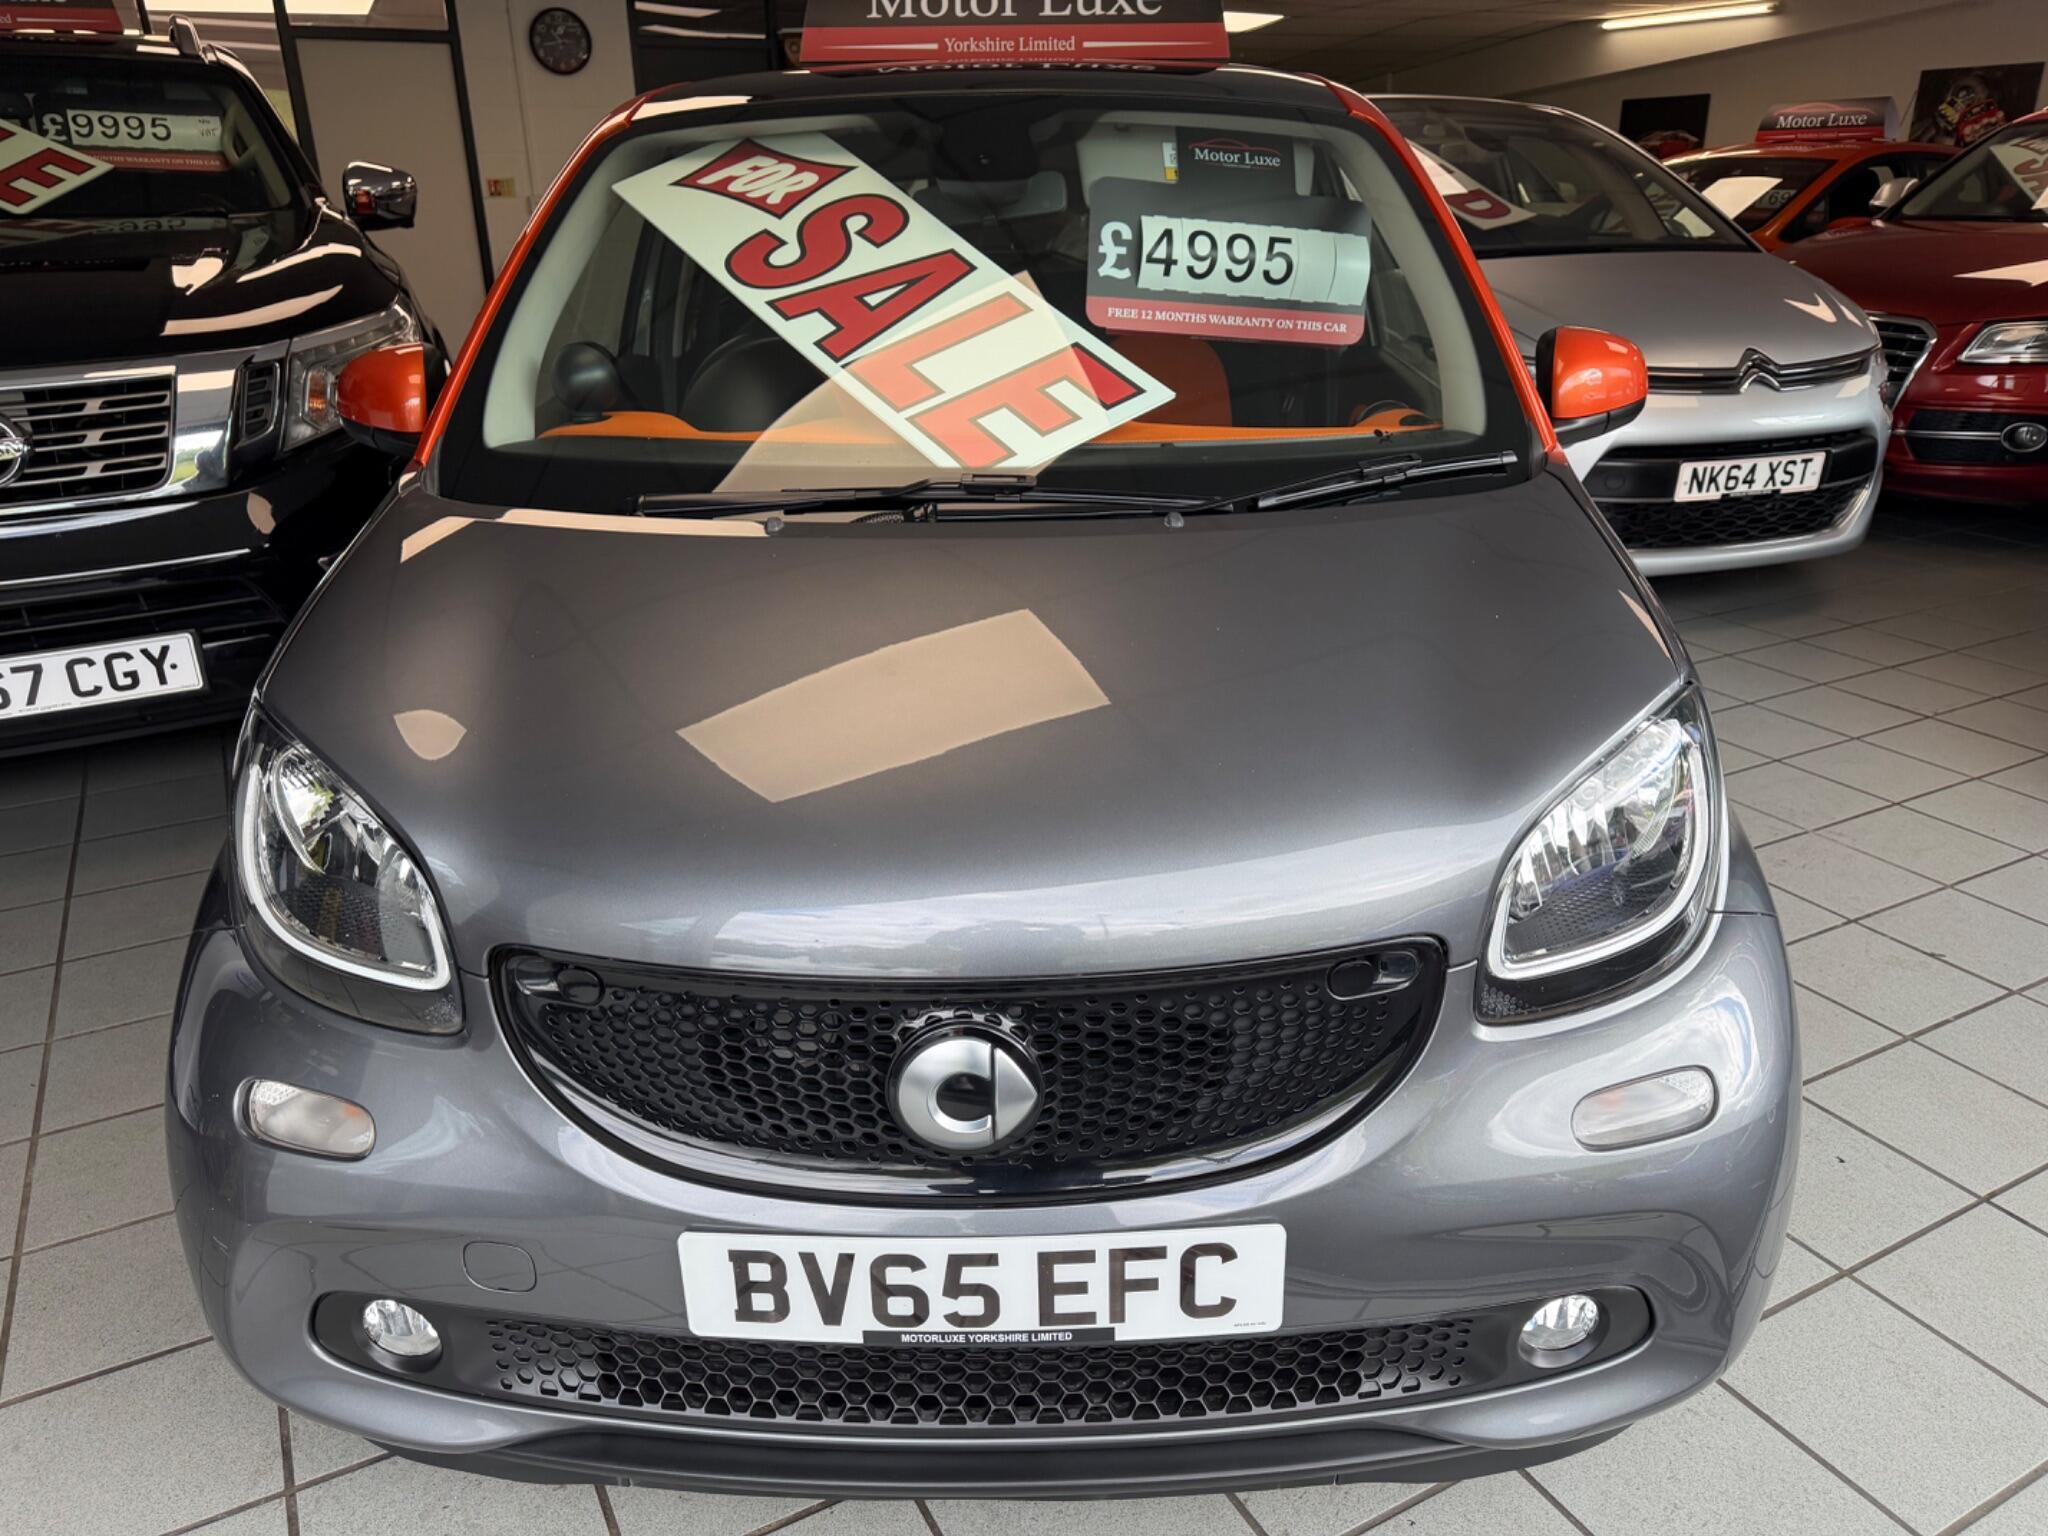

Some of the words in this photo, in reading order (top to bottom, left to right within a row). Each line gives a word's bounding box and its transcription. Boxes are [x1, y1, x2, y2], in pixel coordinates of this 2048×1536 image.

[944, 37, 1015, 53] Yorkshire
[1019, 36, 1076, 51] Limited
[1776, 115, 1824, 128] Motor
[1827, 113, 1868, 126] Luxe
[1194, 148, 1240, 163] Motor
[1244, 151, 1281, 167] Luxe
[696, 154, 820, 205] FOR
[724, 193, 1146, 470] SALE
[1107, 307, 1138, 319] FREE
[1141, 309, 1153, 319] 12
[1155, 310, 1206, 324] MONTHS
[1208, 314, 1275, 329] WARRANTY
[1276, 319, 1294, 330] ON
[1295, 320, 1322, 331] THIS
[1324, 322, 1347, 334] CAR
[1688, 463, 1757, 494] NK64
[1764, 458, 1814, 488] XST
[65, 645, 170, 698] CGY
[728, 1248, 1000, 1328] BV65
[1037, 1242, 1239, 1327] EFC
[901, 1333, 966, 1344] MOTORLUXE
[968, 1332, 1029, 1343] YORKSHIRE
[1032, 1332, 1073, 1342] LIMITED
